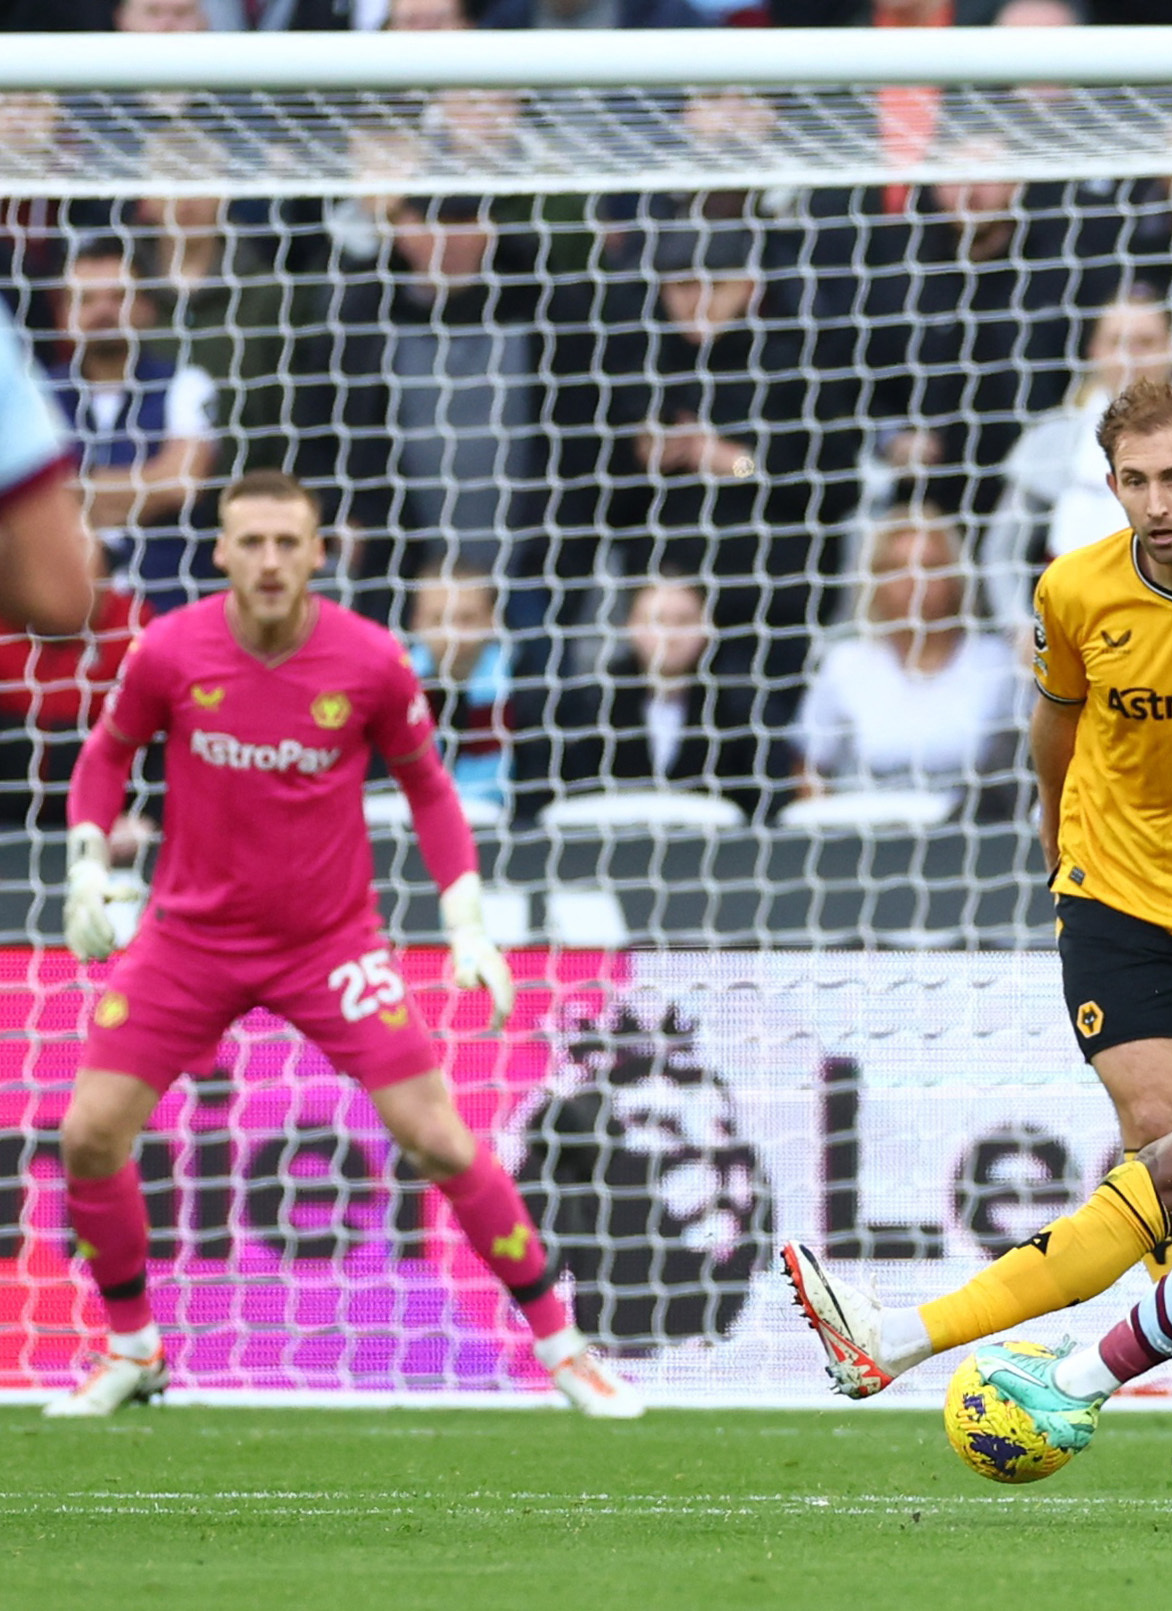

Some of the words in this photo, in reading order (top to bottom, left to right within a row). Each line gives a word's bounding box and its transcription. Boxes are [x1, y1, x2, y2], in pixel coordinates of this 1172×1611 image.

[190, 730, 341, 773] AstroPay
[328, 949, 404, 1022] 25
[824, 1054, 1122, 1262] Le
